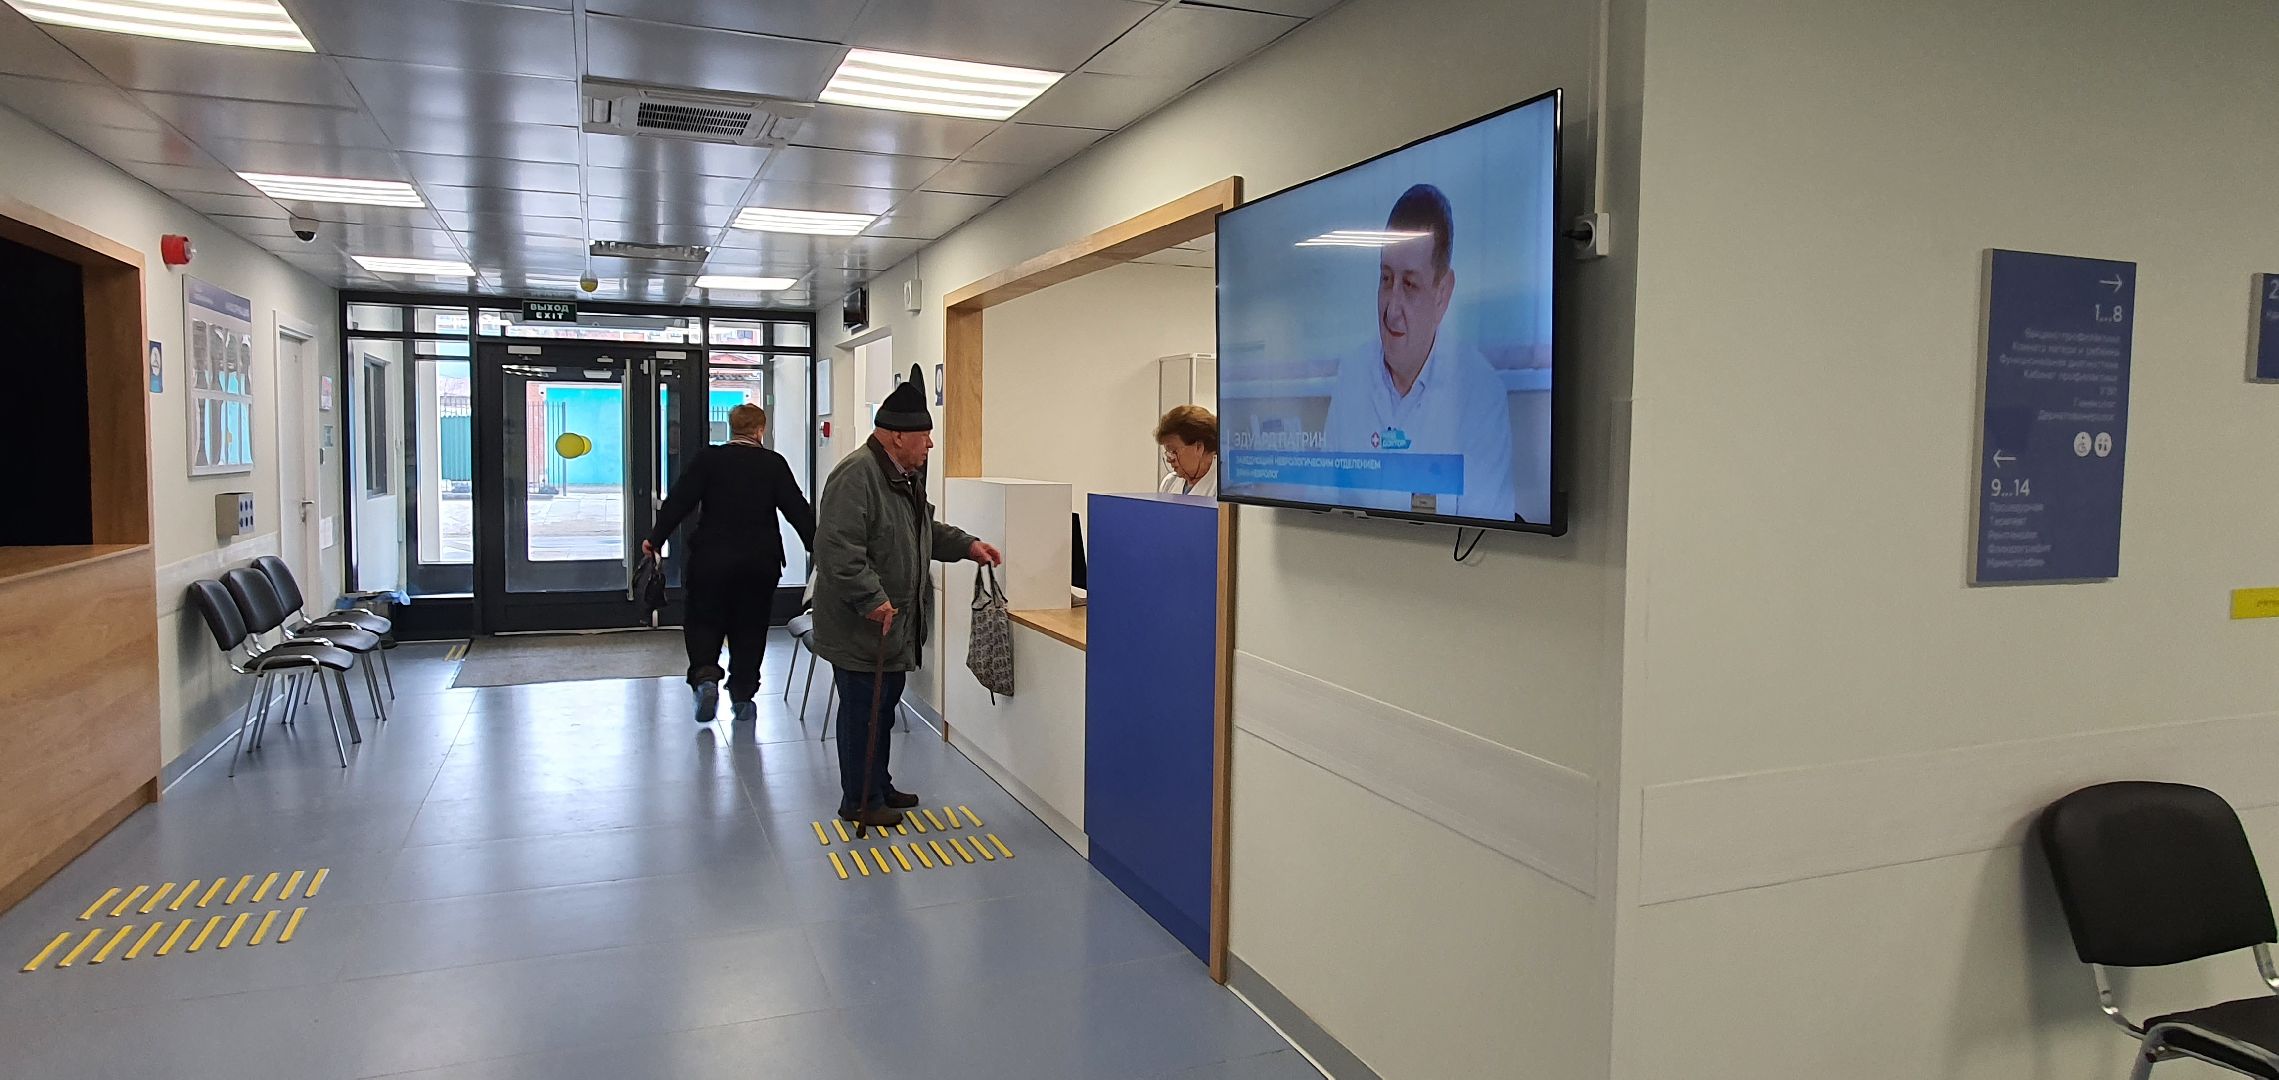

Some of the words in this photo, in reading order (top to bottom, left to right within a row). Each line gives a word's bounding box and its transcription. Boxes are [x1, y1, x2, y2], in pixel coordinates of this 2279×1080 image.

[530, 303, 569, 313] ВЫХОД
[535, 312, 564, 320] EXIT
[1234, 431, 1277, 449] ЭДУАРД
[1278, 431, 1327, 449] ПАТРИН
